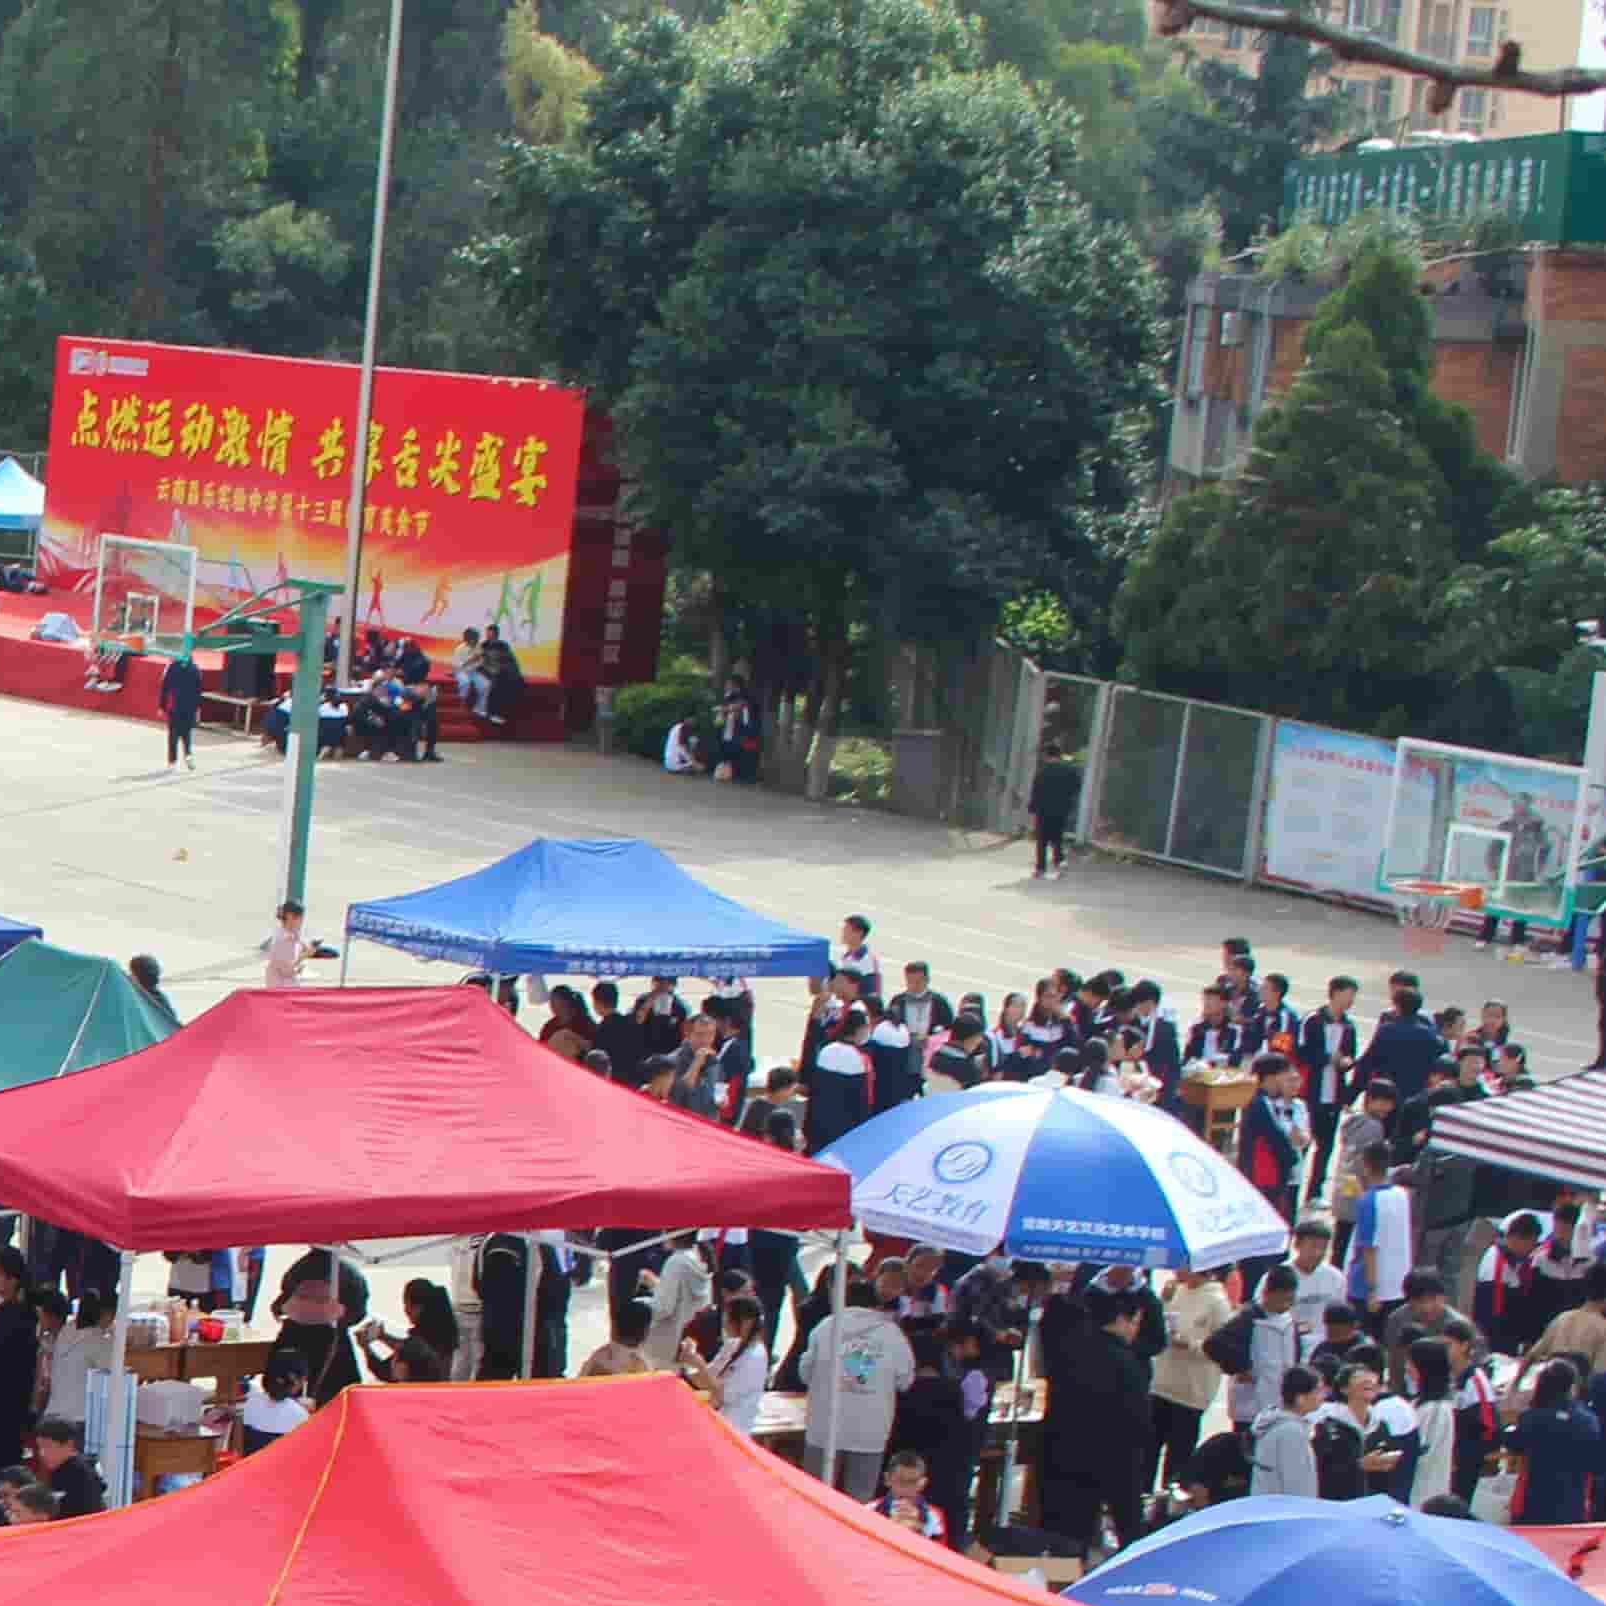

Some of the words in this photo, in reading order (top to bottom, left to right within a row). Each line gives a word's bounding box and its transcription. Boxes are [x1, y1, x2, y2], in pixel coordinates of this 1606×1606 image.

[70, 386, 294, 475] 点燃运动激情
